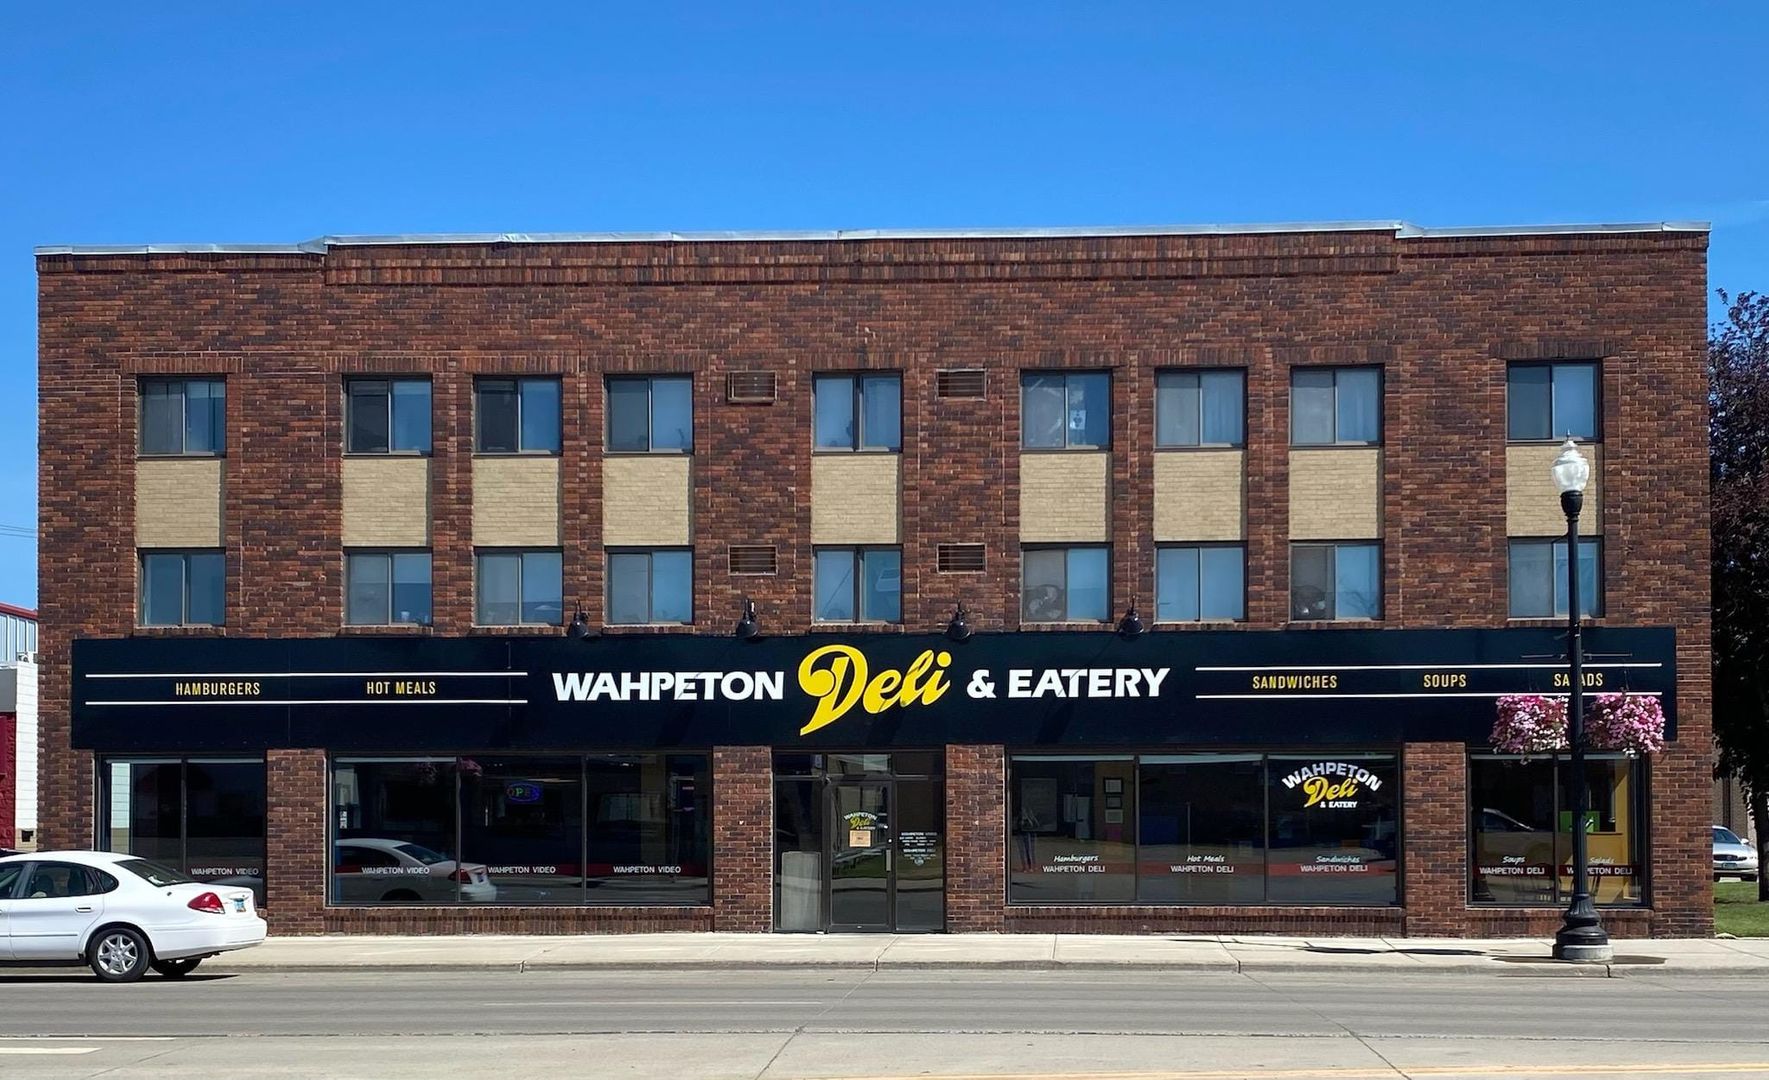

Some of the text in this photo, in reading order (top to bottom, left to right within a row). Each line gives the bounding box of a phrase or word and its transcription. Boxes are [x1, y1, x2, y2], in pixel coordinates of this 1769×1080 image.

[1252, 675, 1338, 690] SANDWICHES
[1423, 673, 1467, 688] SOUPS
[1553, 672, 1603, 687] SAADS
[175, 682, 261, 696] HAMBURGERS
[366, 681, 436, 695] HOT MEALS
[552, 644, 1171, 736] WAHPETON Deli & EATERY
[1281, 762, 1383, 792] WAHPETON
[1303, 776, 1358, 808] Deli
[1053, 854, 1099, 864] Hamburgers
[1186, 855, 1225, 863] Hot Meals
[1315, 855, 1360, 863] Sandwiches
[1502, 856, 1526, 865] Soups
[191, 867, 259, 876] WAHPETON VIDEO
[361, 866, 430, 875] WAHPETON VIDEO
[487, 866, 556, 874] WAHPETON VIDEO
[613, 866, 682, 874] WAHPETON VIDEO
[1042, 865, 1106, 873] WAHPETON DELI
[1170, 865, 1234, 873] WAHPETON DELI
[1479, 867, 1545, 875] WAHPETON DELI
[1566, 867, 1633, 875] WPETON DELI
